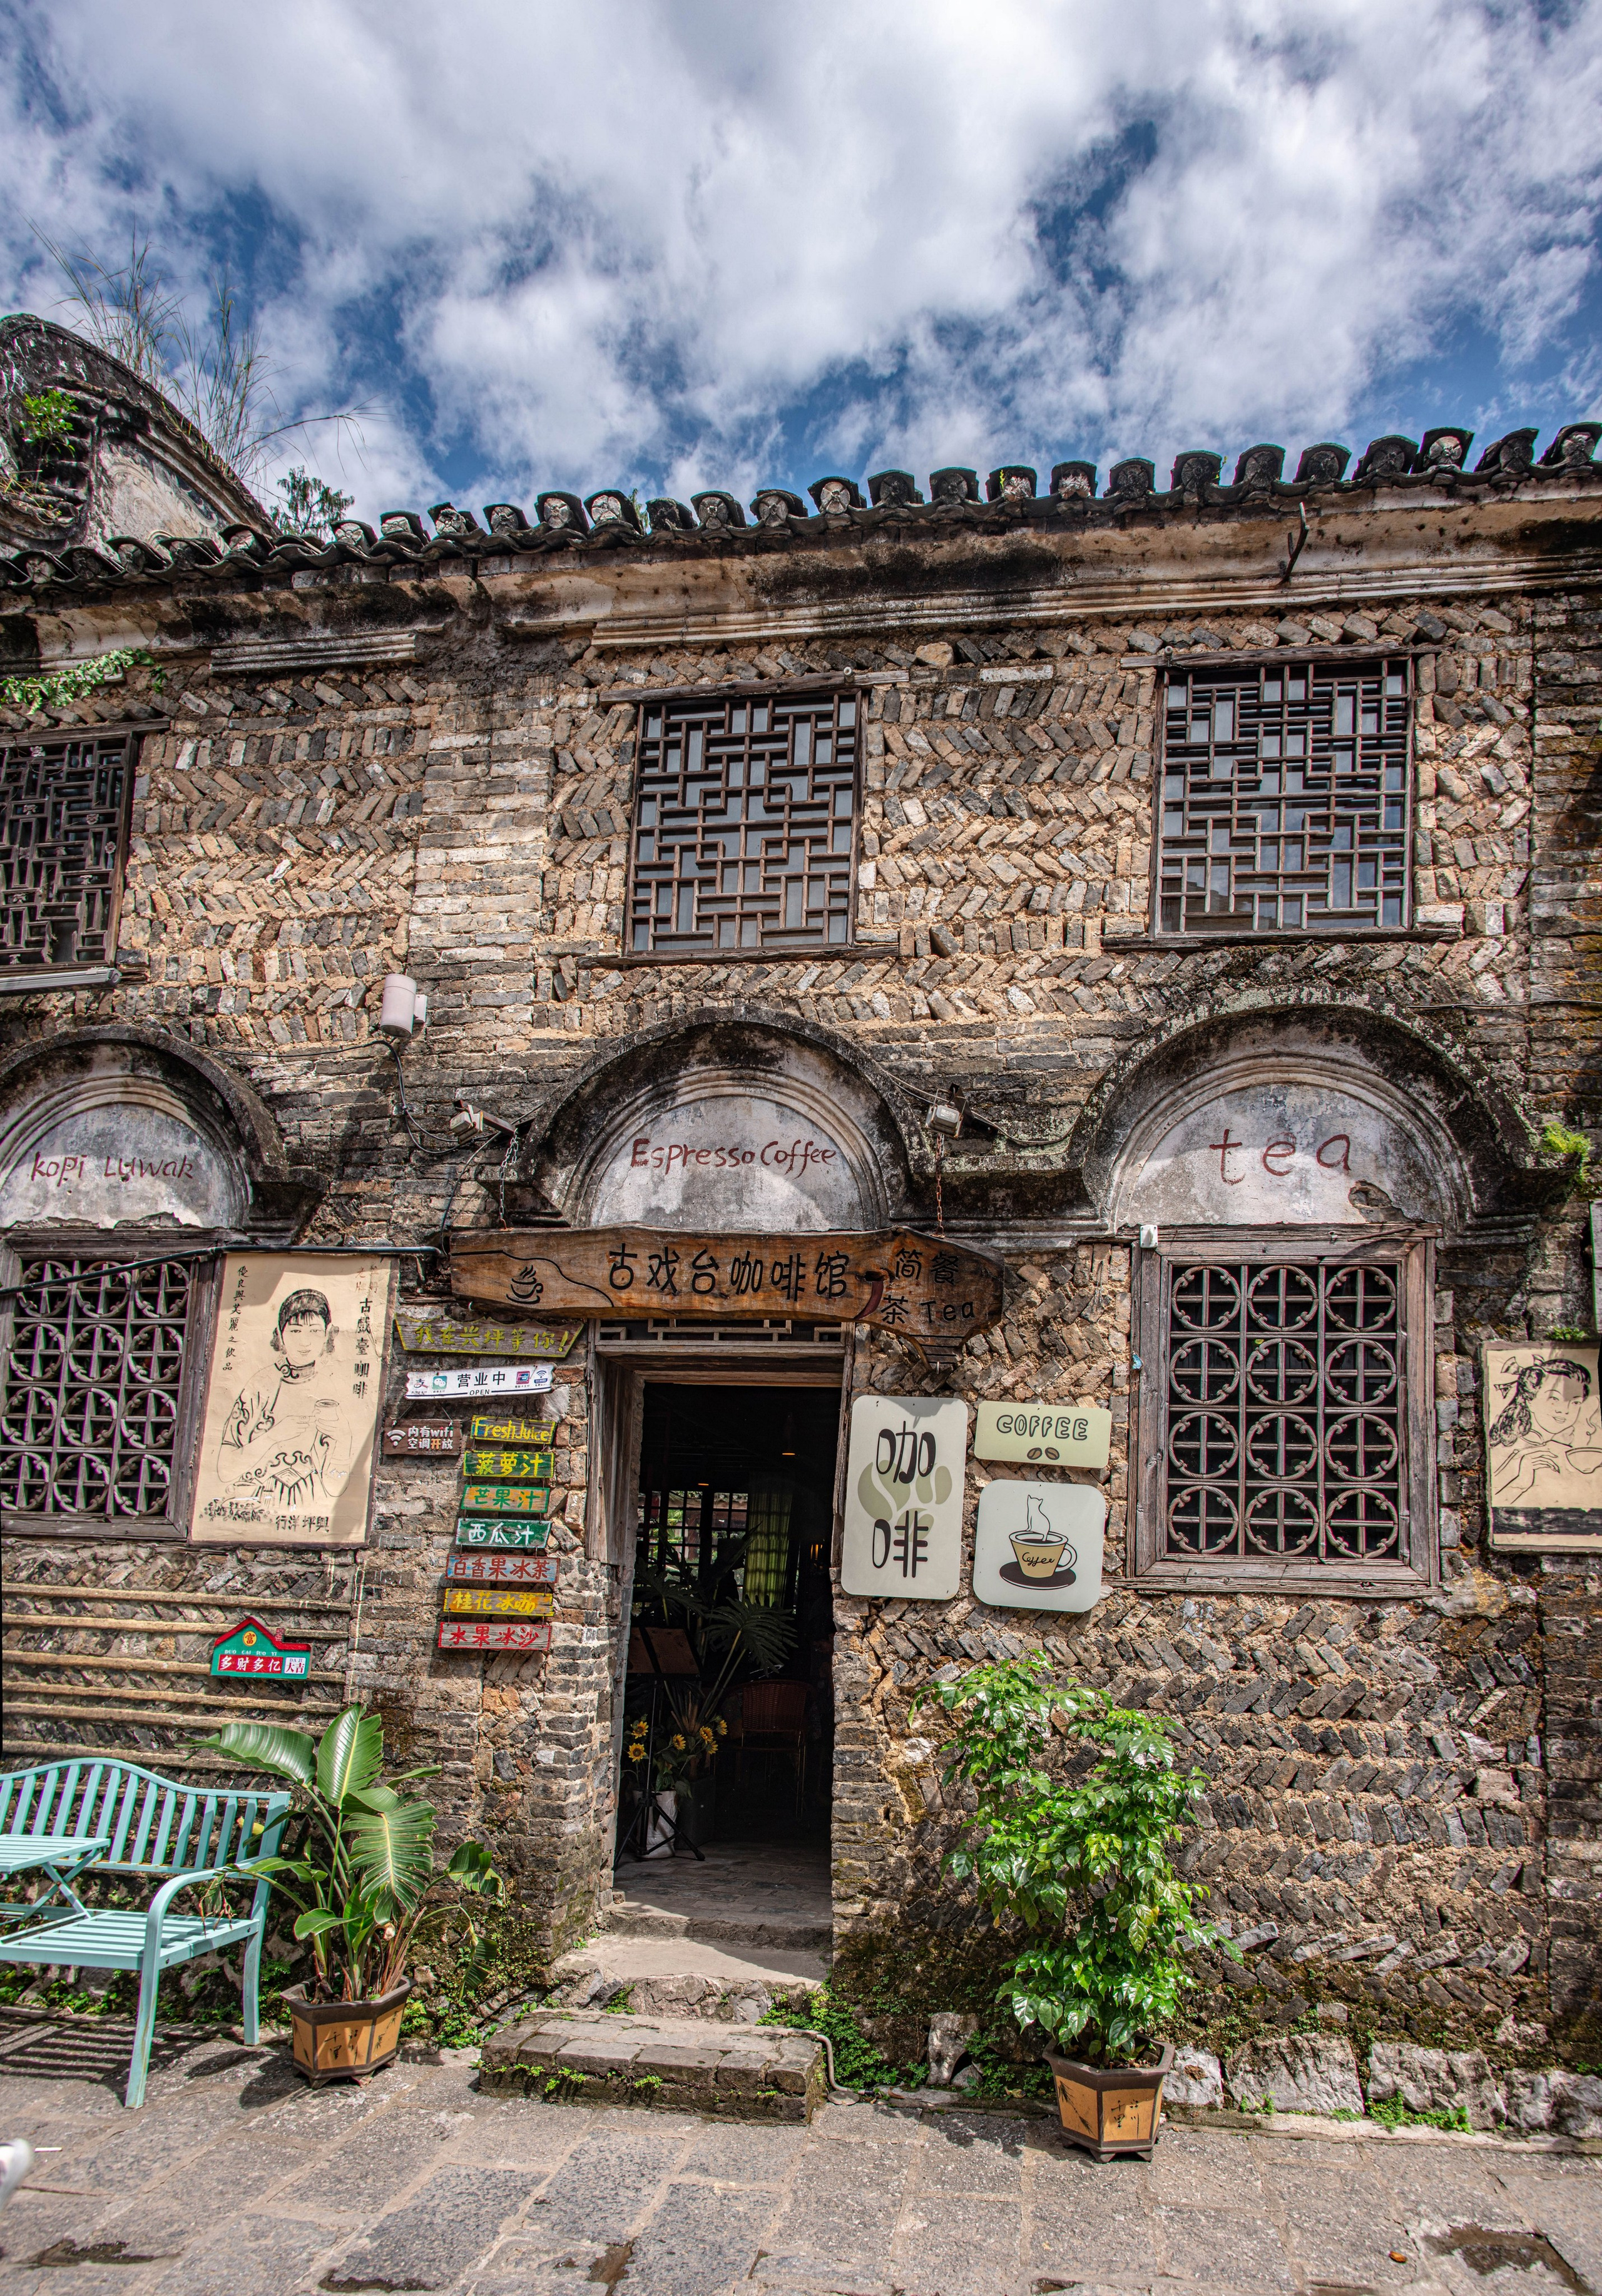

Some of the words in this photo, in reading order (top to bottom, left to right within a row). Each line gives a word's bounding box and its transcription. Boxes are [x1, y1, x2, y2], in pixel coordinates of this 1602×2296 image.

[1209, 1128, 1352, 1185] tea
[609, 1243, 849, 1302] 古戏台咖啡馆
[895, 1247, 959, 1286] 简餐
[920, 1300, 976, 1324] Tea
[457, 1370, 506, 1388] 营业中
[996, 1414, 1089, 1441] COFFEE
[407, 1438, 454, 1450] 空调开放
[476, 1452, 543, 1476] 菠萝汁
[474, 1488, 541, 1509] 芒果汁
[872, 1421, 936, 1578] 咖啡
[469, 1522, 534, 1546] 西瓜汁
[454, 1557, 551, 1579] 百香果冰茶
[1022, 1552, 1055, 1566] Coffee
[449, 1625, 539, 1648] 水果冰沙
[219, 1655, 281, 1672] 多财多亿
[285, 1662, 305, 1673] 大吉
